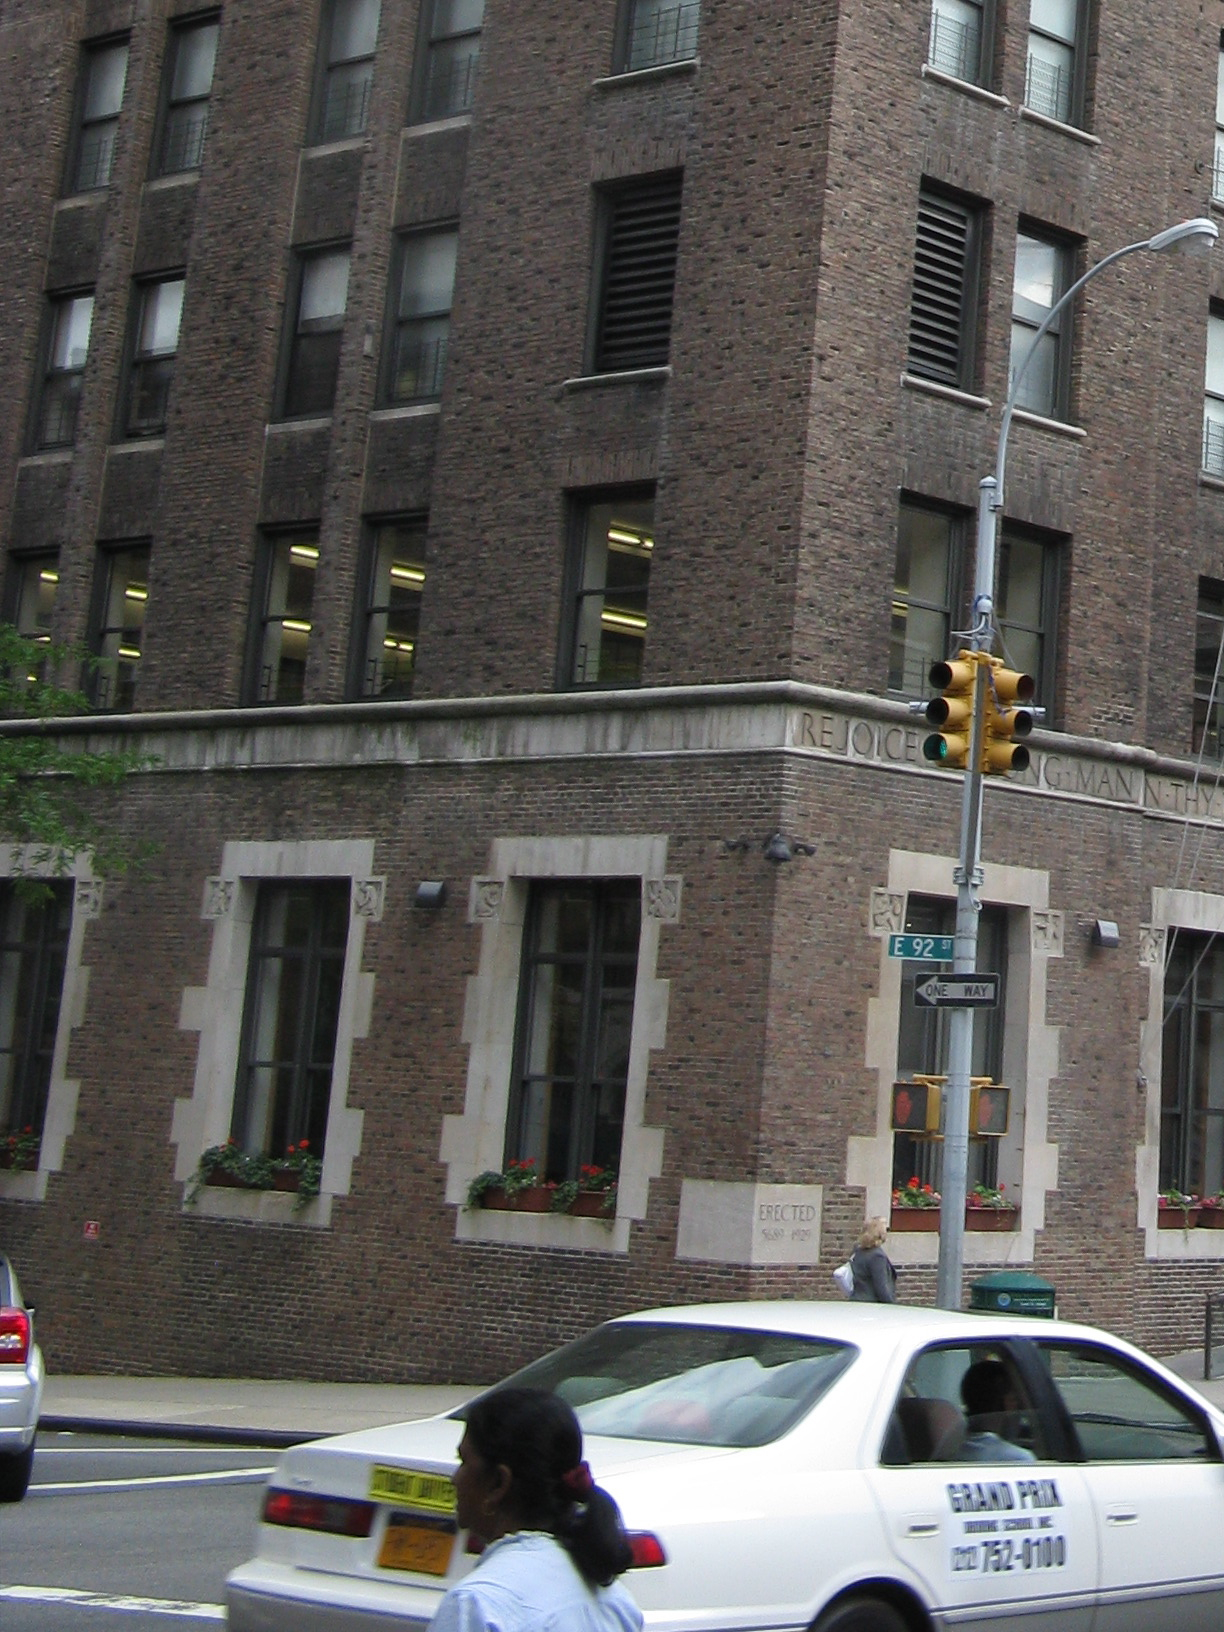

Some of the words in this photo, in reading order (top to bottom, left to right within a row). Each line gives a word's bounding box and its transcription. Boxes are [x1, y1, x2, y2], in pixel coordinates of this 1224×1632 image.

[801, 712, 918, 762] REJOICE
[1076, 760, 1134, 798] MAN
[1171, 781, 1217, 815] THY
[894, 937, 904, 956] E
[912, 938, 934, 957] 92
[941, 939, 952, 949] ST
[925, 984, 948, 996] ONE
[964, 984, 988, 997] WAY
[759, 1204, 816, 1222] ERECTED
[947, 1481, 1014, 1513] GRAND
[1016, 1479, 1064, 1508] PRIX
[981, 1535, 1066, 1573] 752-0100
